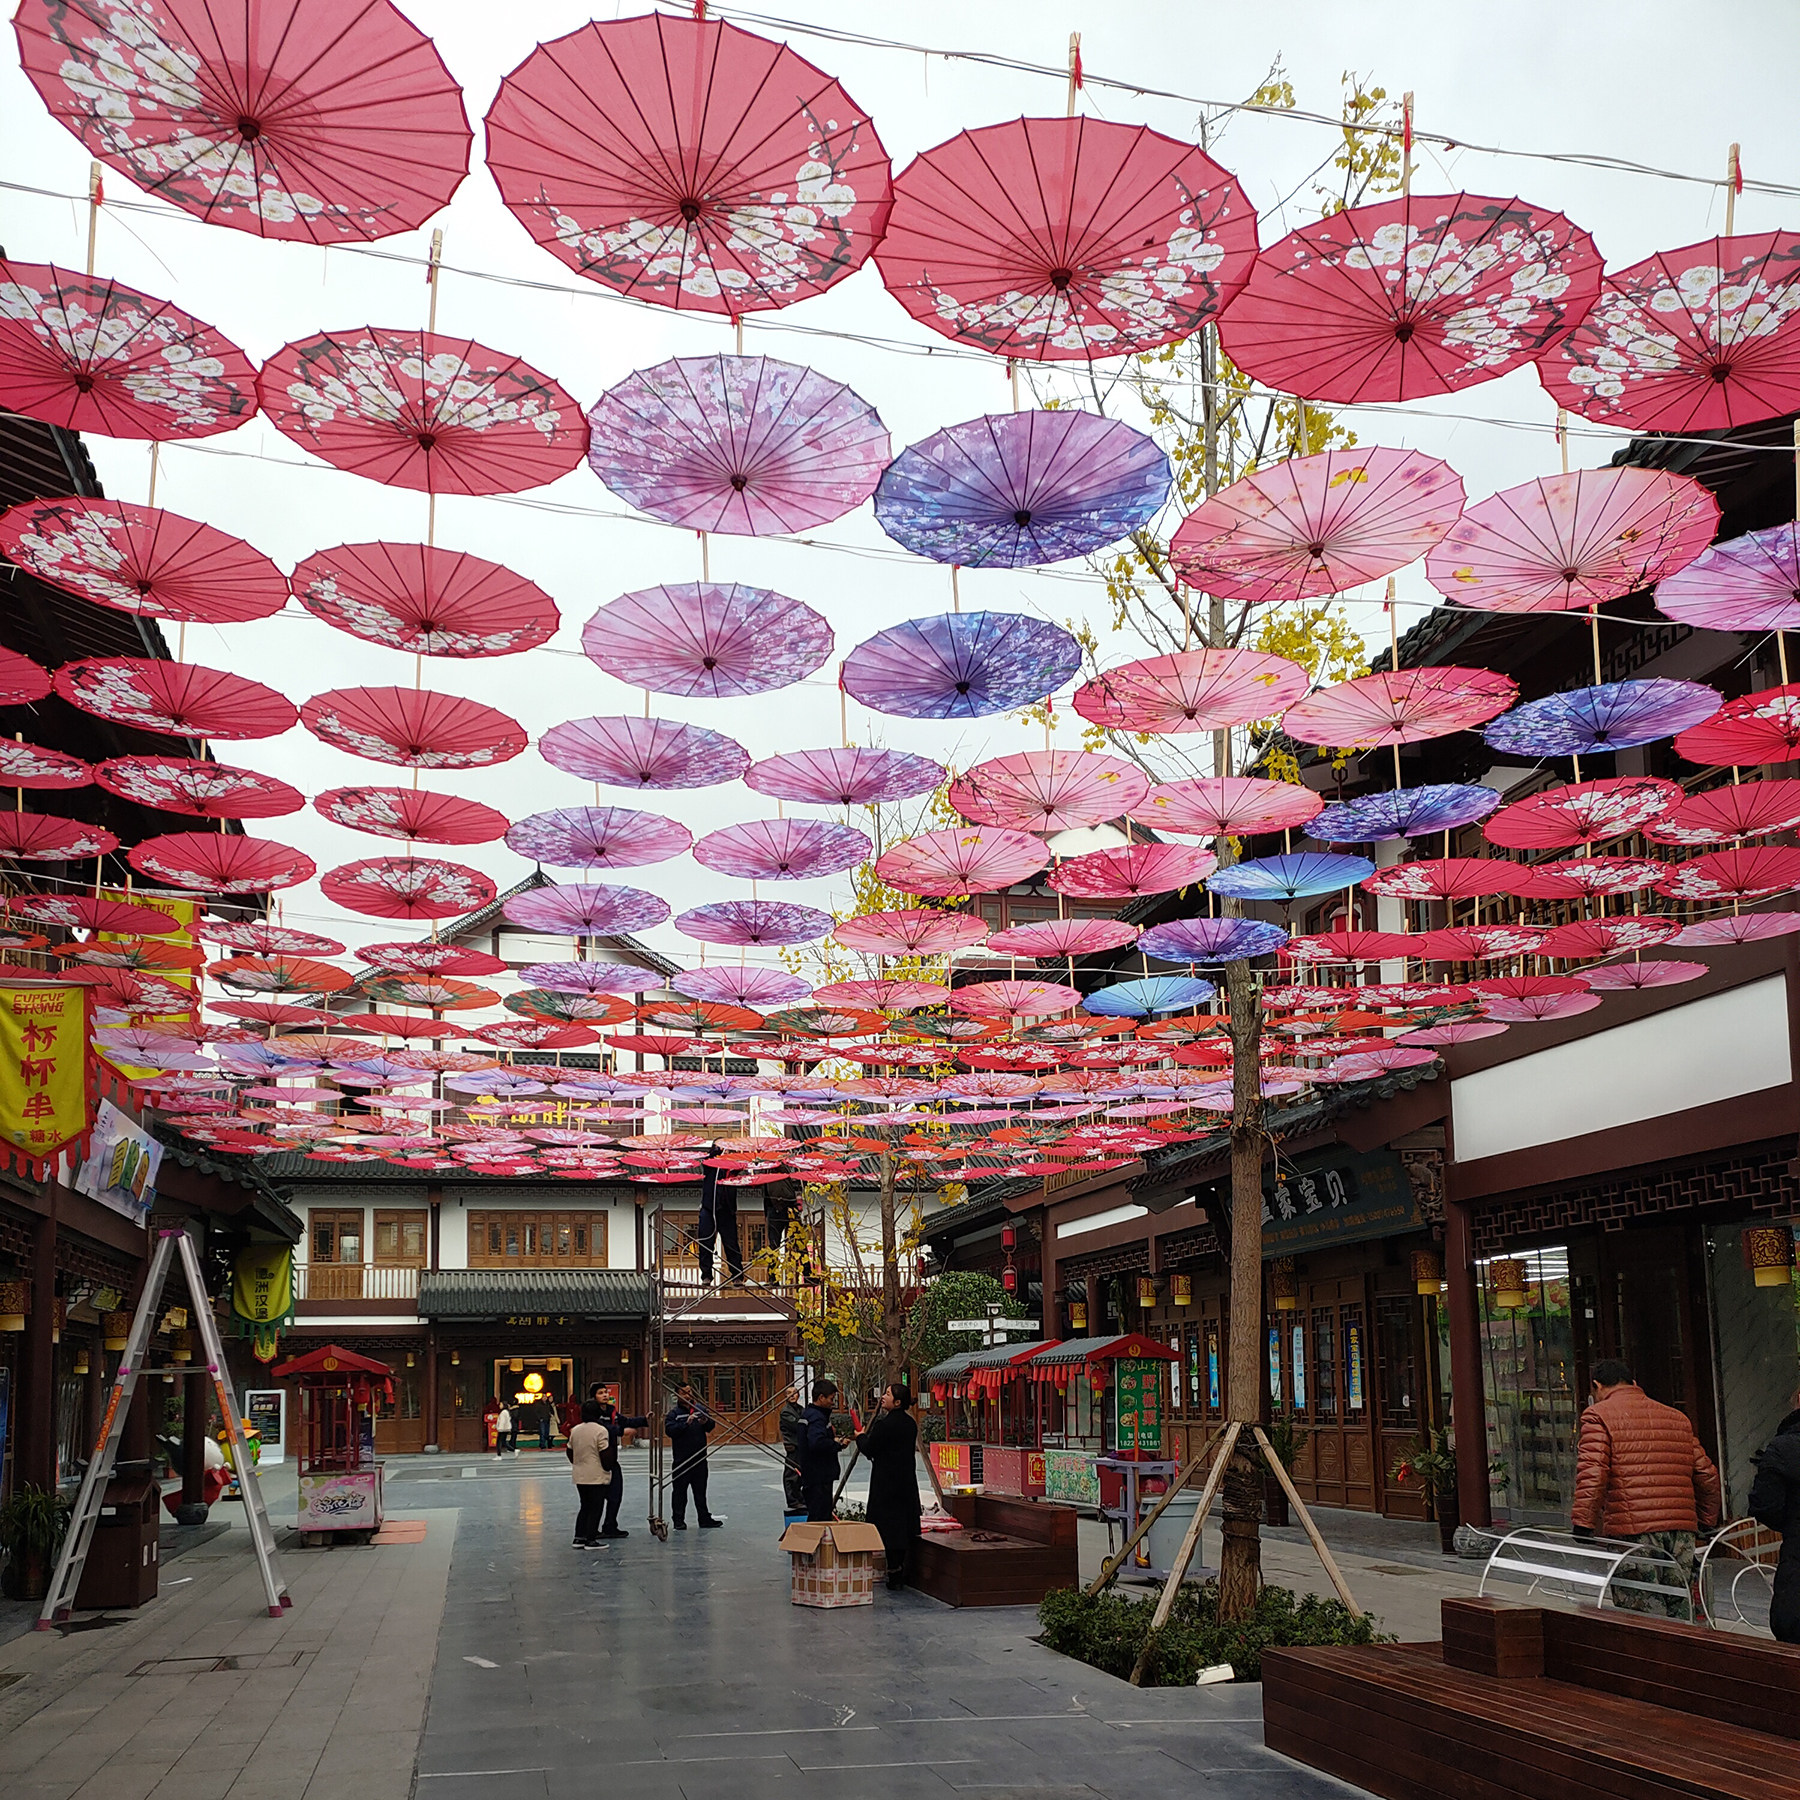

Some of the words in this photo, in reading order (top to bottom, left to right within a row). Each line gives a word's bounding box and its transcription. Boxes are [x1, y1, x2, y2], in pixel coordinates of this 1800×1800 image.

[13, 992, 65, 1003] CUPCUP
[20, 1018, 57, 1126] 杯杯串
[30, 1129, 63, 1143] 糖水
[326, 1357, 337, 1368] 10
[1127, 1432, 1153, 1440] 加电话
